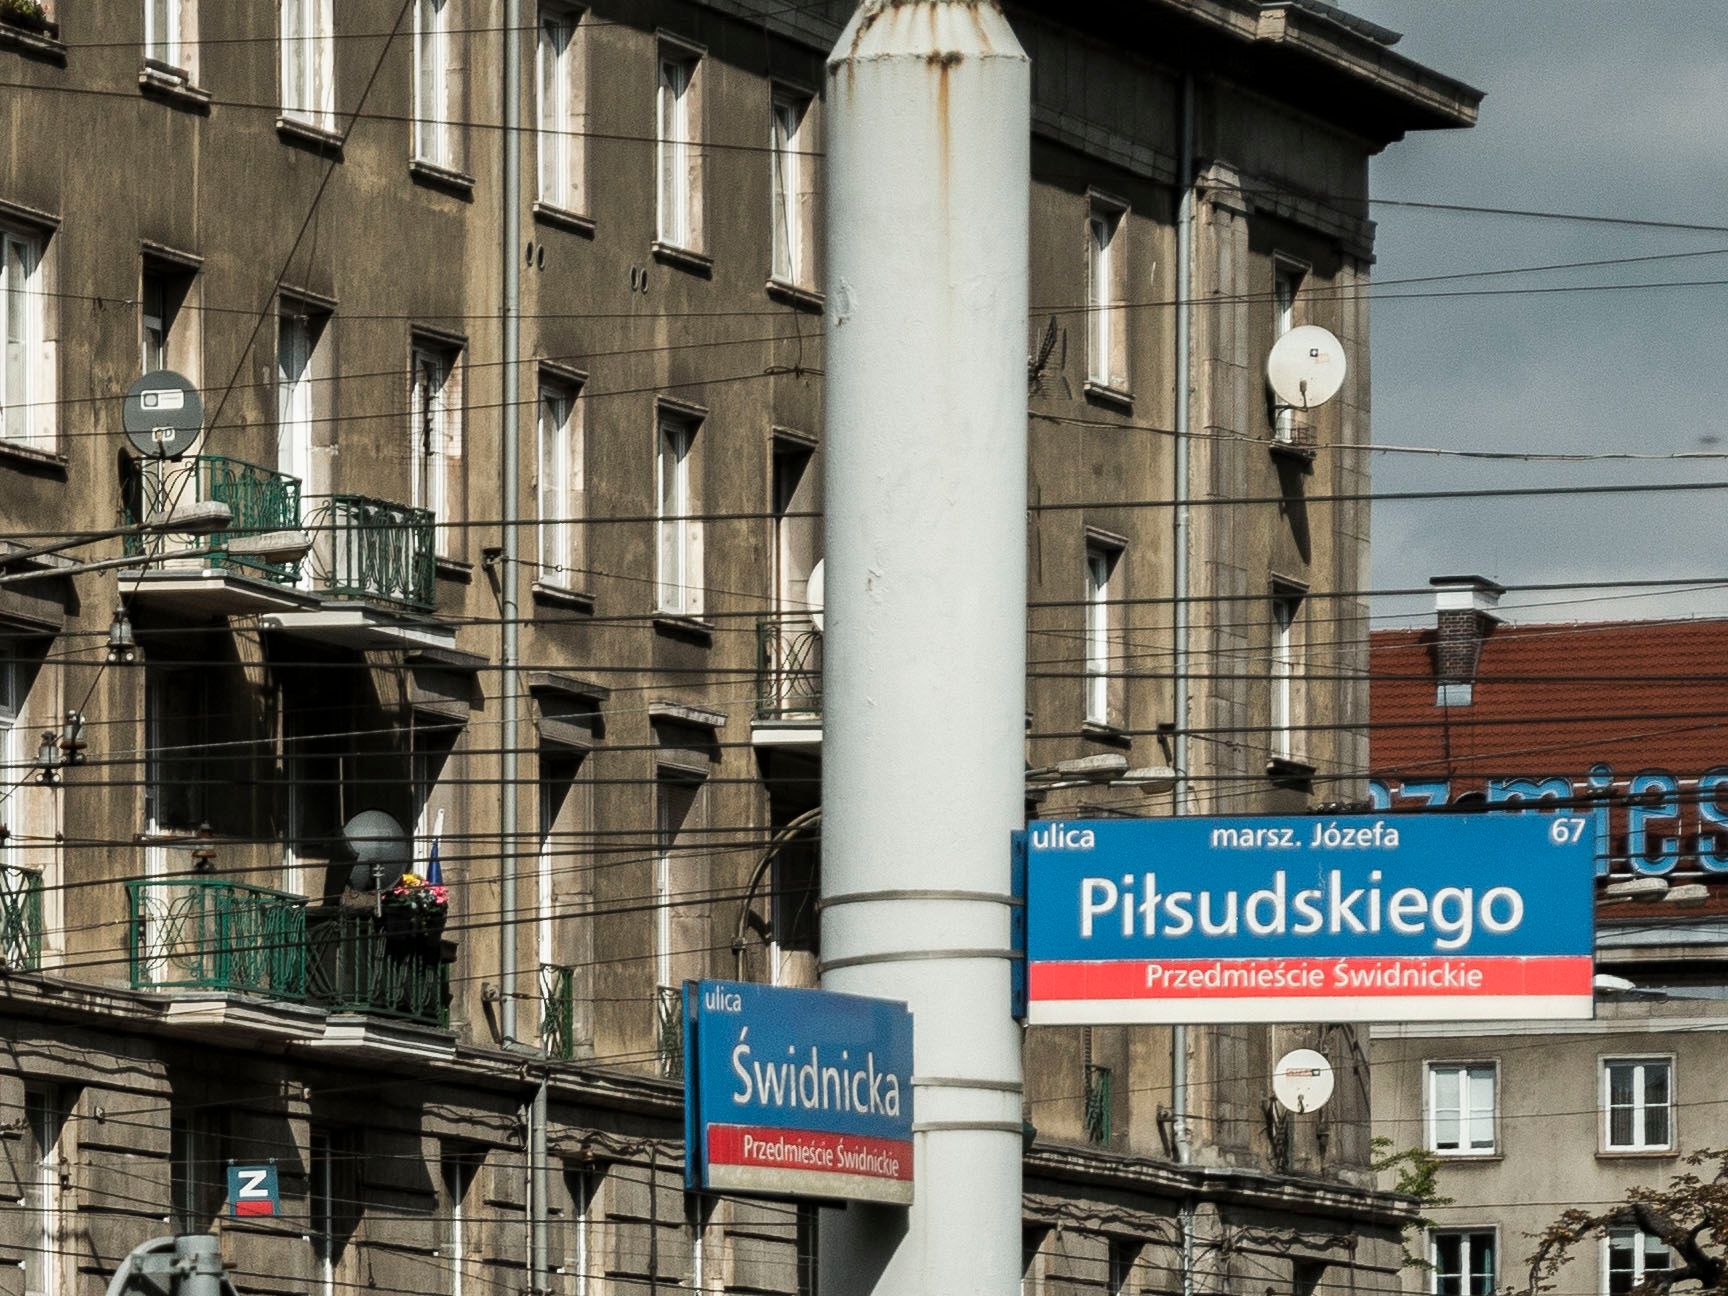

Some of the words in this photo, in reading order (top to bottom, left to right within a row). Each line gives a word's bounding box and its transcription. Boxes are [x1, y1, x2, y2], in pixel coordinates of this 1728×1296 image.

[1032, 823, 1096, 850] ulica
[1212, 826, 1302, 850] marsz.
[1310, 820, 1401, 851] Józefa
[1551, 819, 1586, 844] 67
[1079, 869, 1525, 949] Piłsudskiego
[1145, 961, 1325, 989] Przedmieście
[1333, 957, 1484, 989] Świdnickie
[704, 985, 743, 1013] ulica
[731, 1026, 901, 1117] Świdnicka
[743, 1134, 835, 1167] Przedmieście
[837, 1137, 900, 1177] Świdnickie
